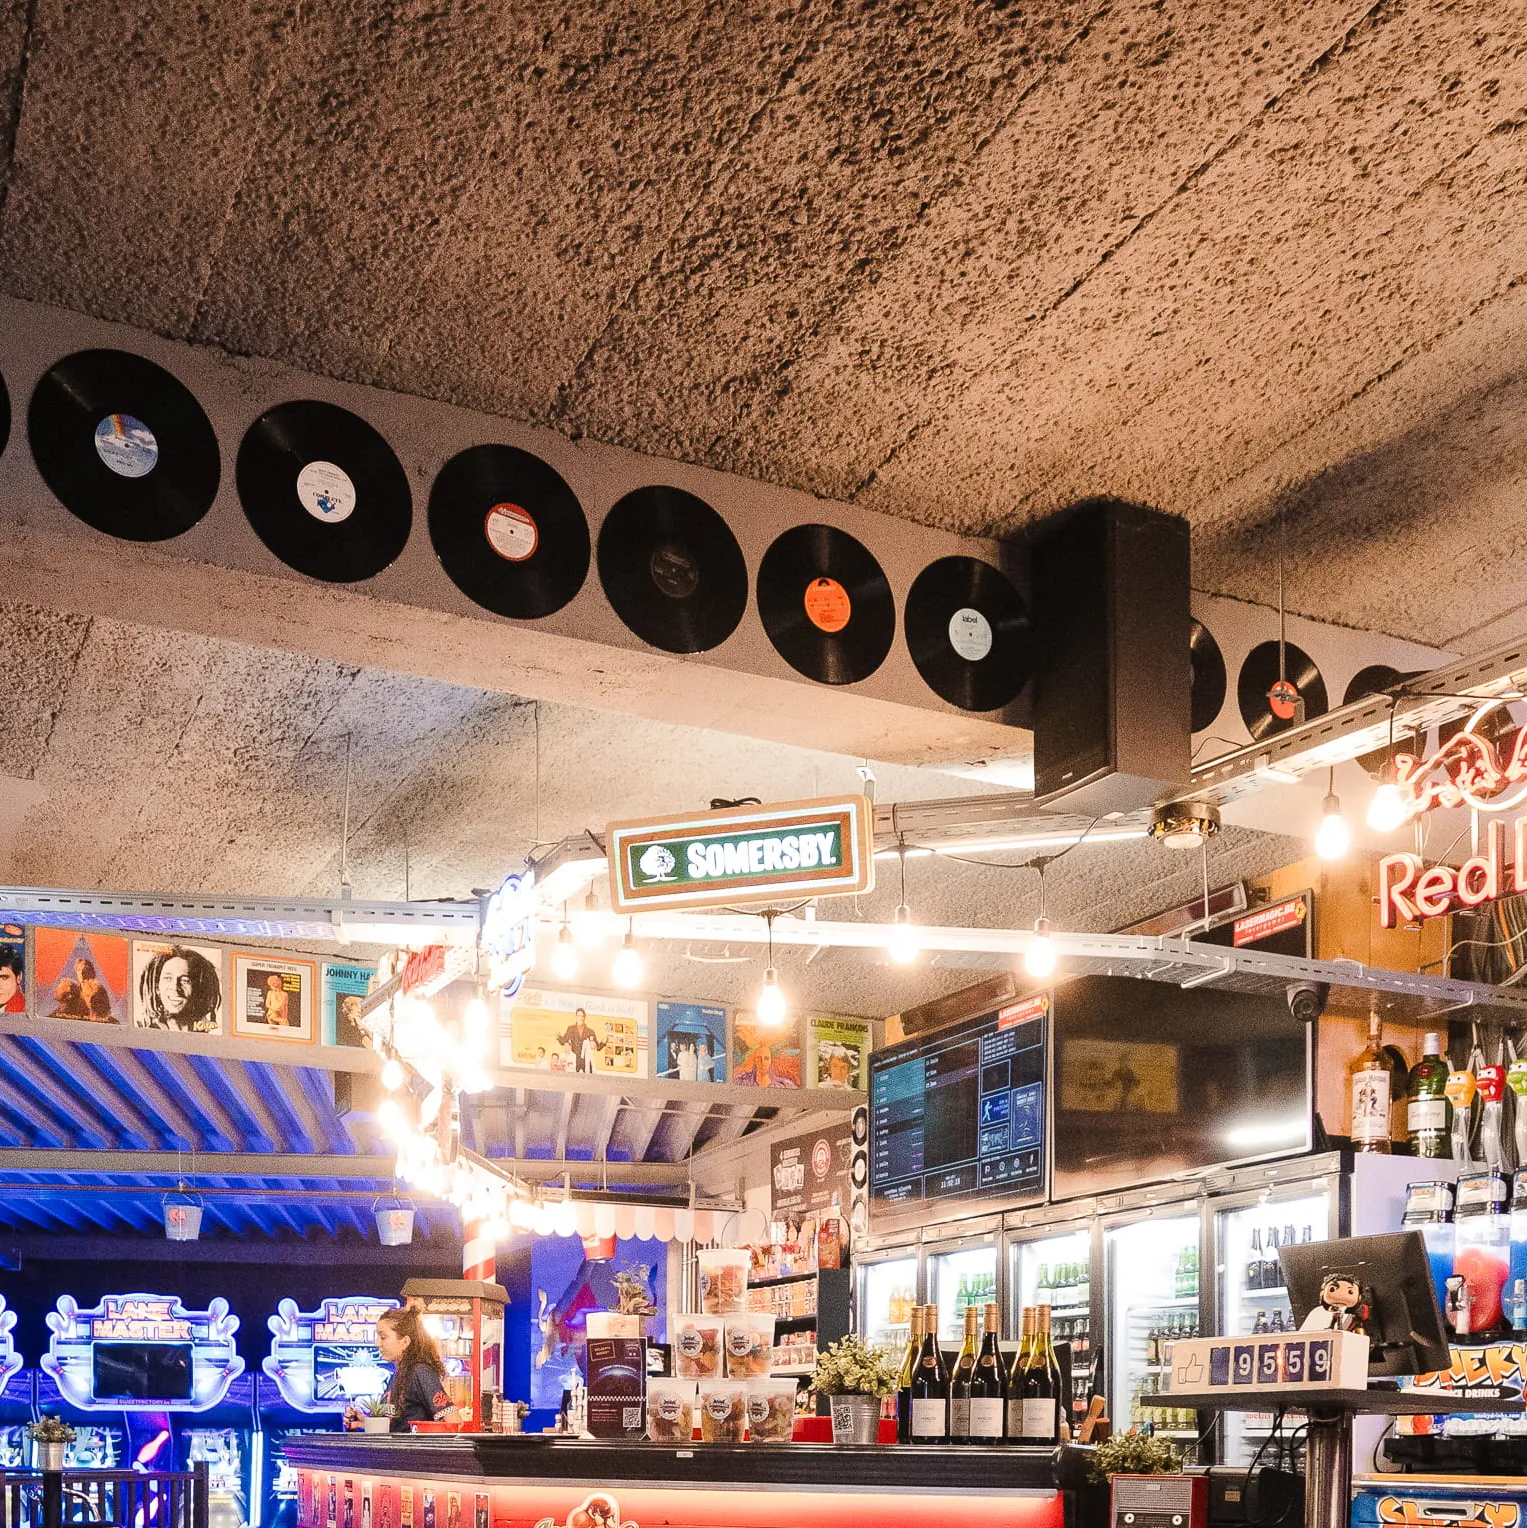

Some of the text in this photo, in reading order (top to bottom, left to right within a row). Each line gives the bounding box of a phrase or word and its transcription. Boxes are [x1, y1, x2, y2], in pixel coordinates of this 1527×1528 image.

[1378, 819, 1505, 929] Red
[325, 968, 358, 981] JOHNNY
[106, 1300, 171, 1320] LANE
[92, 1319, 192, 1340] MASTER
[314, 1321, 379, 1343] MAST
[1465, 1388, 1500, 1398] DRINKS
